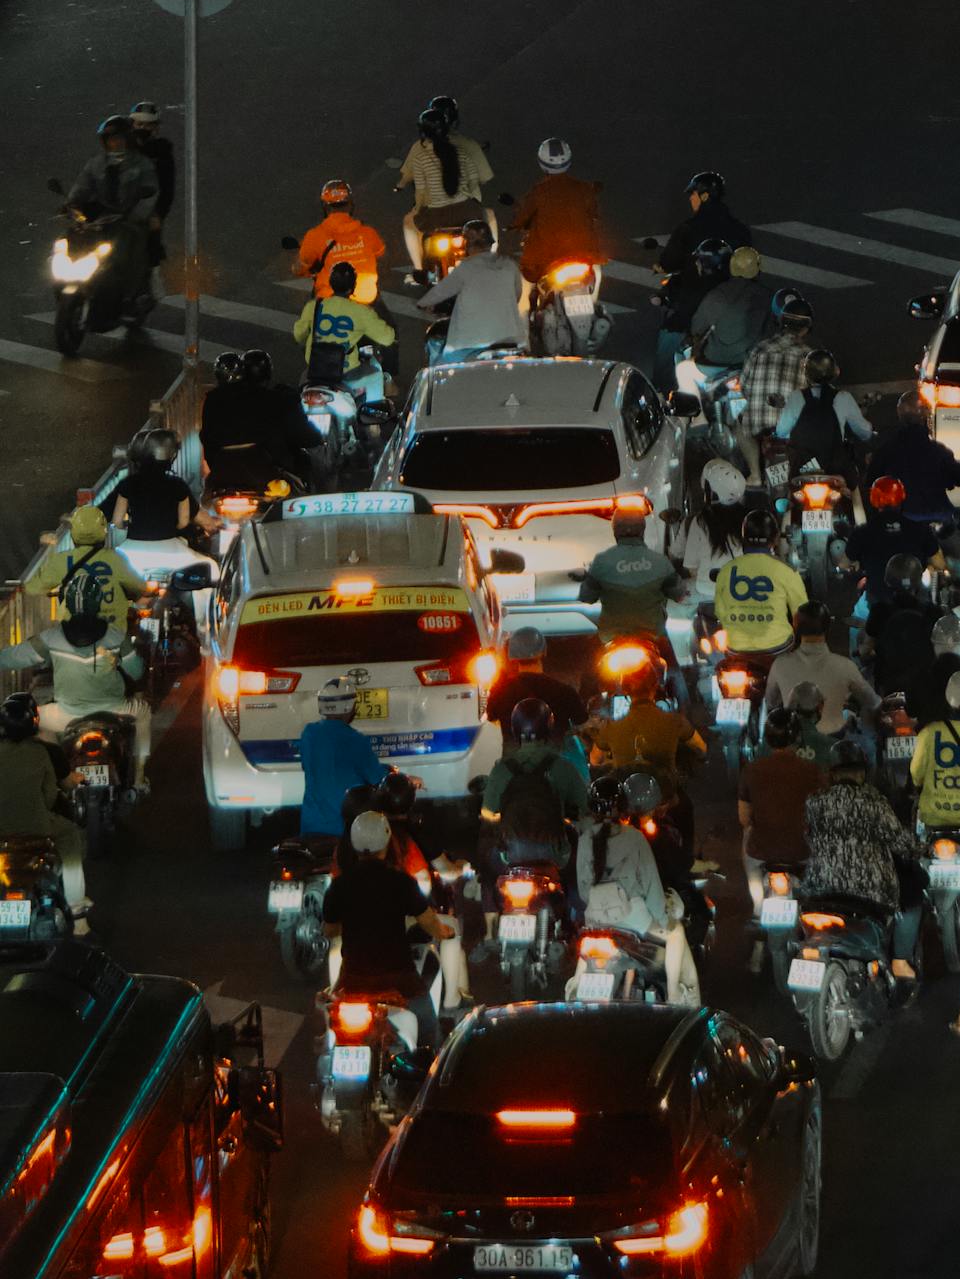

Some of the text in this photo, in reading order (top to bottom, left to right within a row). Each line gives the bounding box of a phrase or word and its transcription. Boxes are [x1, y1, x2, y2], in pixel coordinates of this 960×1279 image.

[317, 303, 354, 338] be
[341, 500, 360, 513] 27
[365, 500, 384, 512] 27
[388, 498, 409, 511] 27
[616, 557, 652, 573] Grab
[730, 565, 774, 601] be
[258, 600, 280, 615] ĐÈN
[282, 600, 303, 611] LED
[381, 591, 411, 606] THIẾT
[416, 593, 427, 607] BỊ
[430, 591, 455, 605] ĐIỆN
